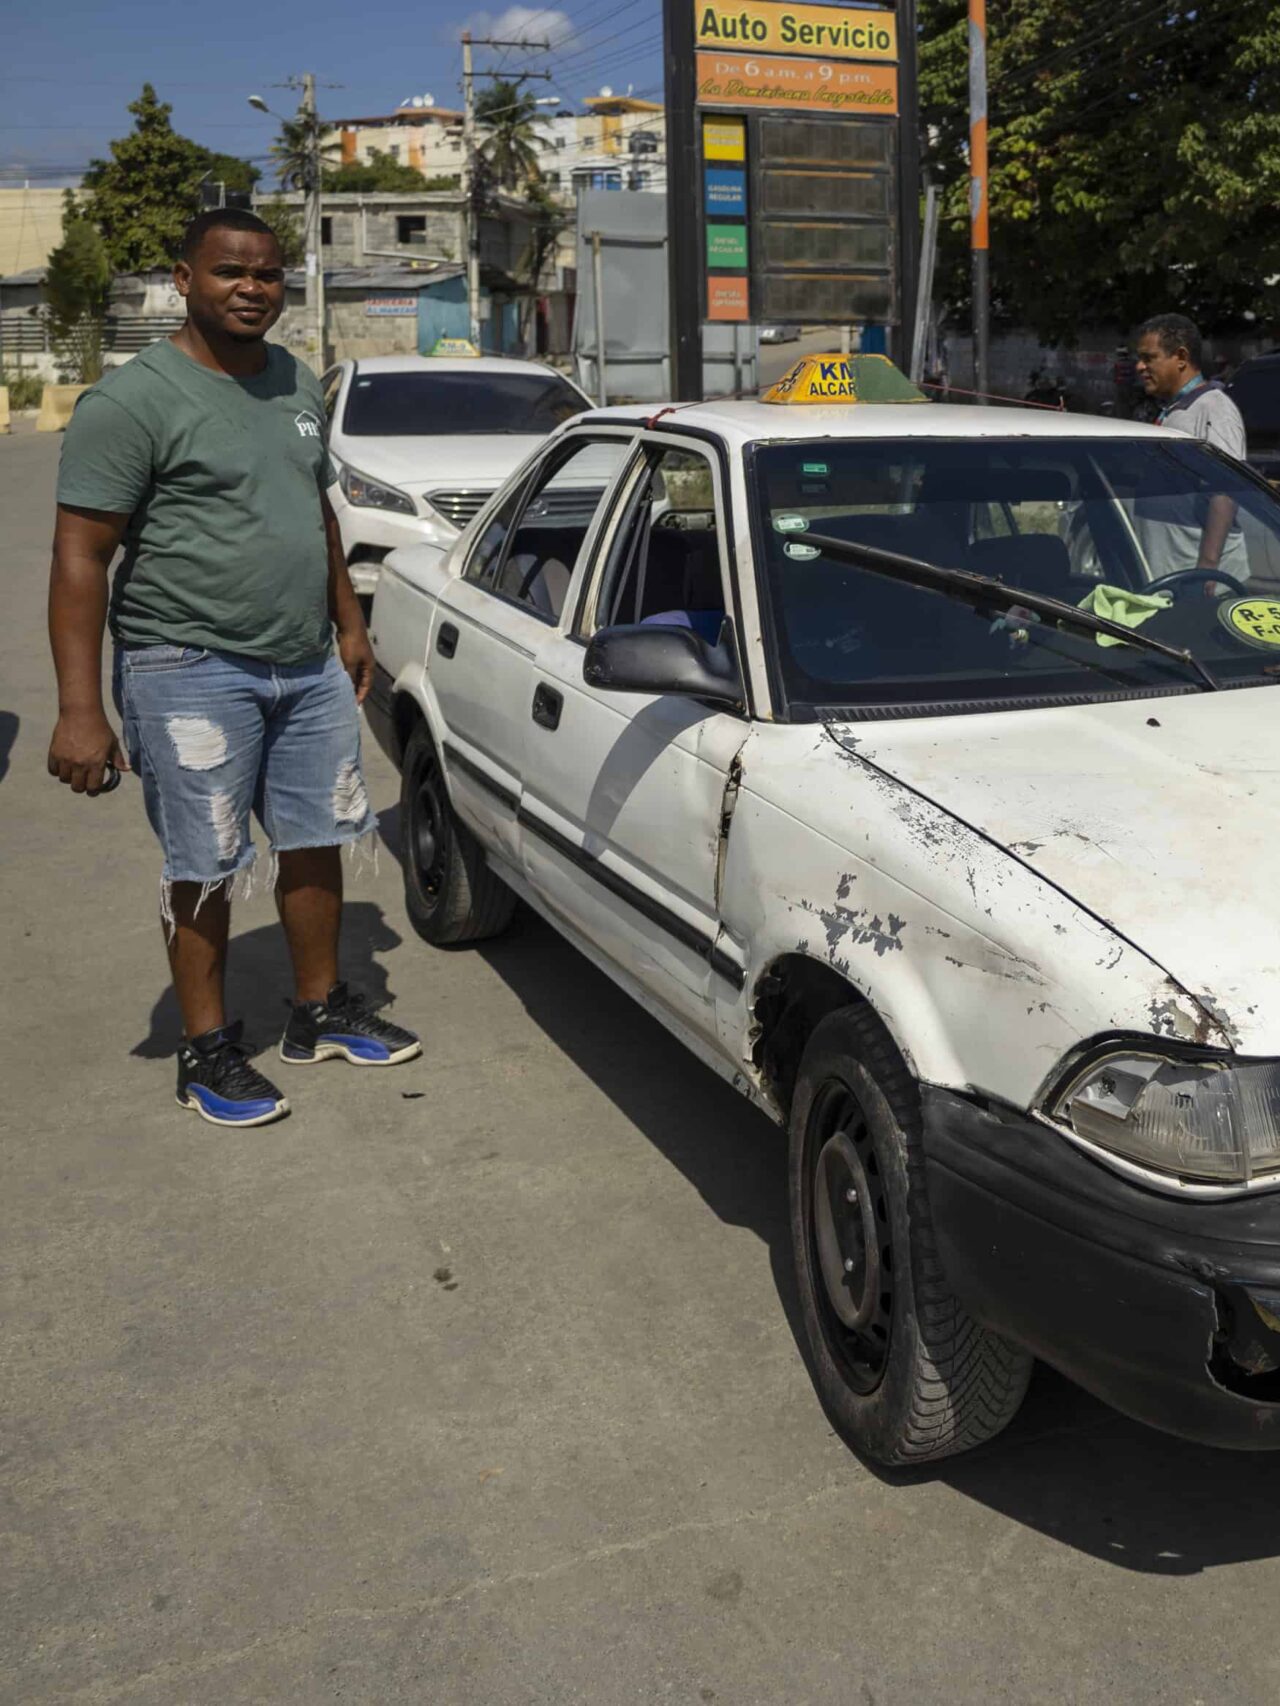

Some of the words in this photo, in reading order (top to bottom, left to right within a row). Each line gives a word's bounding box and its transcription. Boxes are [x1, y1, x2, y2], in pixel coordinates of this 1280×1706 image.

[700, 8, 767, 42] Auto
[781, 15, 891, 50] Servicio
[716, 61, 740, 75] De
[744, 60, 760, 77] 6
[764, 67, 800, 80] a.m.
[804, 70, 814, 81] a
[818, 64, 833, 81] 9
[839, 73, 875, 86] p.m.
[700, 78, 722, 96] La
[723, 79, 810, 101] Dominicana
[809, 382, 858, 396] ALCAR
